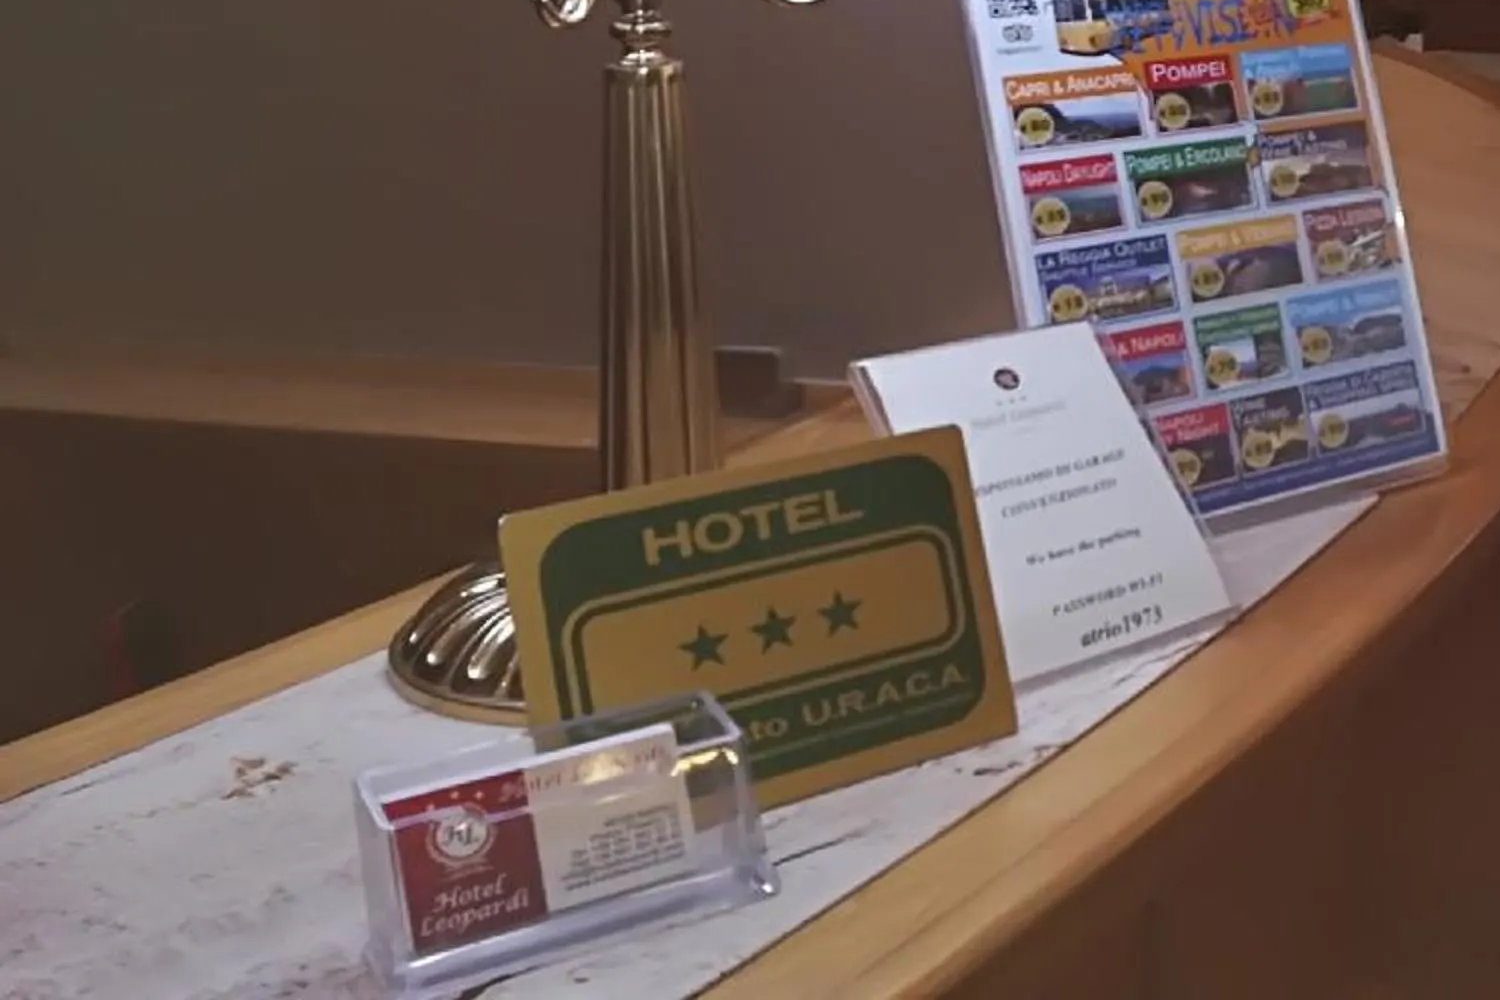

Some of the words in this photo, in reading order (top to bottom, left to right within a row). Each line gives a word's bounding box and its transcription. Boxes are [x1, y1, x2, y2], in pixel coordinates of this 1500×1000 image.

[1006, 79, 1049, 100] CAPRI
[1067, 72, 1136, 94] ANACAPRI
[1151, 60, 1226, 83] POMPEI
[1128, 156, 1174, 174] POMPEI
[1037, 256, 1056, 270] LA
[1114, 237, 1166, 257] OUTLET
[1130, 331, 1183, 352] NAPOLI
[1073, 448, 1125, 471] GARAGE
[642, 489, 865, 567] HOTEL
[1048, 547, 1075, 560] have
[1079, 540, 1095, 552] the
[1099, 527, 1141, 549] parking
[1053, 584, 1127, 617] PASSWORD
[1129, 571, 1163, 593] WI-FI
[1080, 604, 1163, 648] atrio1973
[432, 873, 507, 913] Hotel
[420, 887, 530, 938] Leopardi
